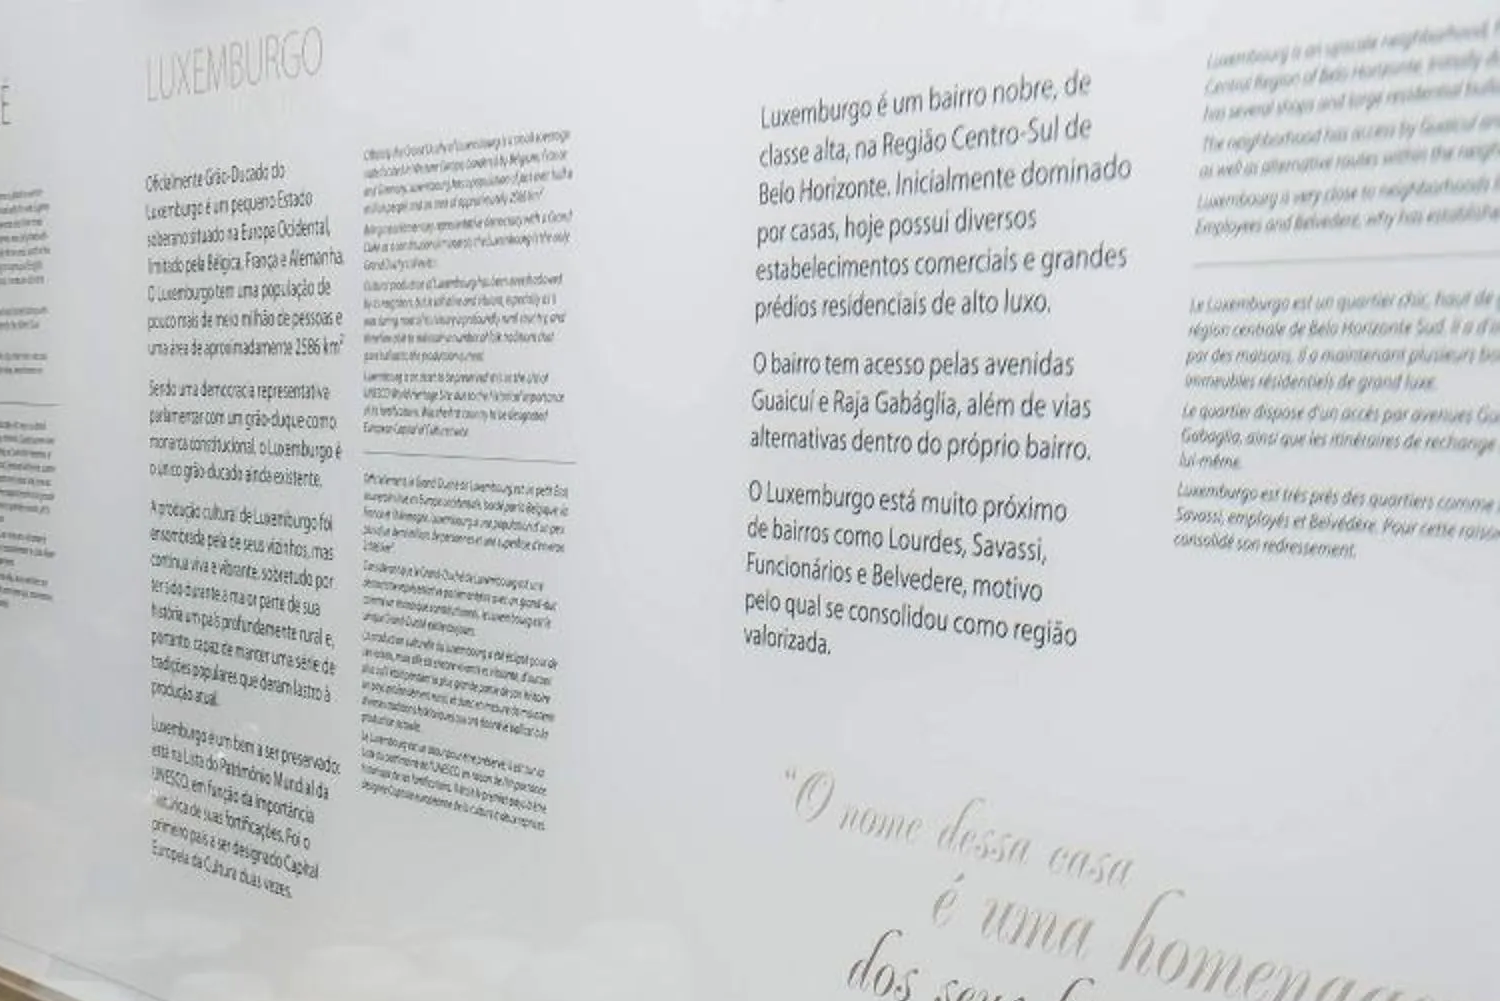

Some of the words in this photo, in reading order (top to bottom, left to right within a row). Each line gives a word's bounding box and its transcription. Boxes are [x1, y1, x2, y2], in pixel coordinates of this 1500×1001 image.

[147, 26, 323, 102] LUXEMBURGO
[760, 96, 875, 130] Luxemburgo
[875, 89, 893, 118] é
[891, 94, 924, 116] um
[927, 82, 988, 112] bairro
[991, 74, 1059, 105] nobre,
[1063, 68, 1091, 98] de
[758, 139, 811, 167] classe
[811, 135, 853, 163] alta,
[851, 138, 881, 159] na
[880, 125, 948, 162] Região
[947, 113, 1060, 151] Centro-Sul
[1063, 112, 1092, 141] de
[758, 177, 797, 206] Belo
[795, 174, 891, 203] Horizonte.
[894, 163, 1019, 196] Inicialmente
[1019, 152, 1132, 187] dominado
[755, 224, 788, 251] por
[786, 222, 844, 244] casas,
[842, 211, 889, 245] hoje
[887, 206, 950, 244] possui
[952, 205, 1037, 234] diversos
[755, 251, 913, 281] estabelecimentos
[911, 244, 1019, 275] comerciais
[1021, 251, 1036, 270] e
[1039, 239, 1127, 277] grandes
[753, 291, 820, 325] prédios
[819, 288, 927, 317] residenciais
[927, 288, 957, 315] de
[959, 287, 999, 315] alto
[1002, 286, 1051, 314] luxo.
[752, 350, 768, 375] O
[769, 350, 822, 375] bairro
[820, 353, 860, 375] tem
[861, 357, 928, 376] acesso
[927, 350, 980, 383] pelas
[982, 349, 1075, 376] avenidas
[750, 387, 816, 413] Guaicuí
[814, 395, 833, 413] e
[831, 388, 874, 421] Raja
[872, 389, 963, 422] Gabáglia,
[961, 390, 1017, 417] além
[1015, 391, 1050, 418] de
[1048, 392, 1091, 419] vias
[750, 422, 850, 451] alternativas
[848, 425, 916, 453] dentro
[915, 427, 946, 455] do
[945, 429, 1023, 463] próprio
[1023, 431, 1091, 460] bairro.
[747, 477, 763, 502] O
[763, 478, 879, 516] Luxemburgo
[877, 486, 921, 513] está
[919, 488, 981, 517] muito
[981, 492, 1067, 525] próximo
[746, 512, 771, 539] de
[769, 513, 833, 544] bairros
[831, 526, 889, 549] como
[887, 523, 968, 560] Lourdes,
[966, 529, 1047, 567] Savassi,
[745, 547, 855, 583] Funcionários
[853, 565, 871, 584] e
[869, 559, 971, 598] Belvedere,
[969, 571, 1043, 601] motivo
[743, 588, 783, 619] pelo
[781, 592, 823, 623] qual
[821, 601, 847, 621] se
[845, 601, 950, 632] consolidou
[951, 614, 1011, 638] como
[1011, 615, 1077, 649] região
[743, 620, 831, 655] valorizada.
[839, 804, 923, 844] nome
[937, 797, 1032, 865] dessa
[1047, 846, 1135, 889] casa
[932, 872, 965, 927] é
[980, 899, 1096, 960] uma
